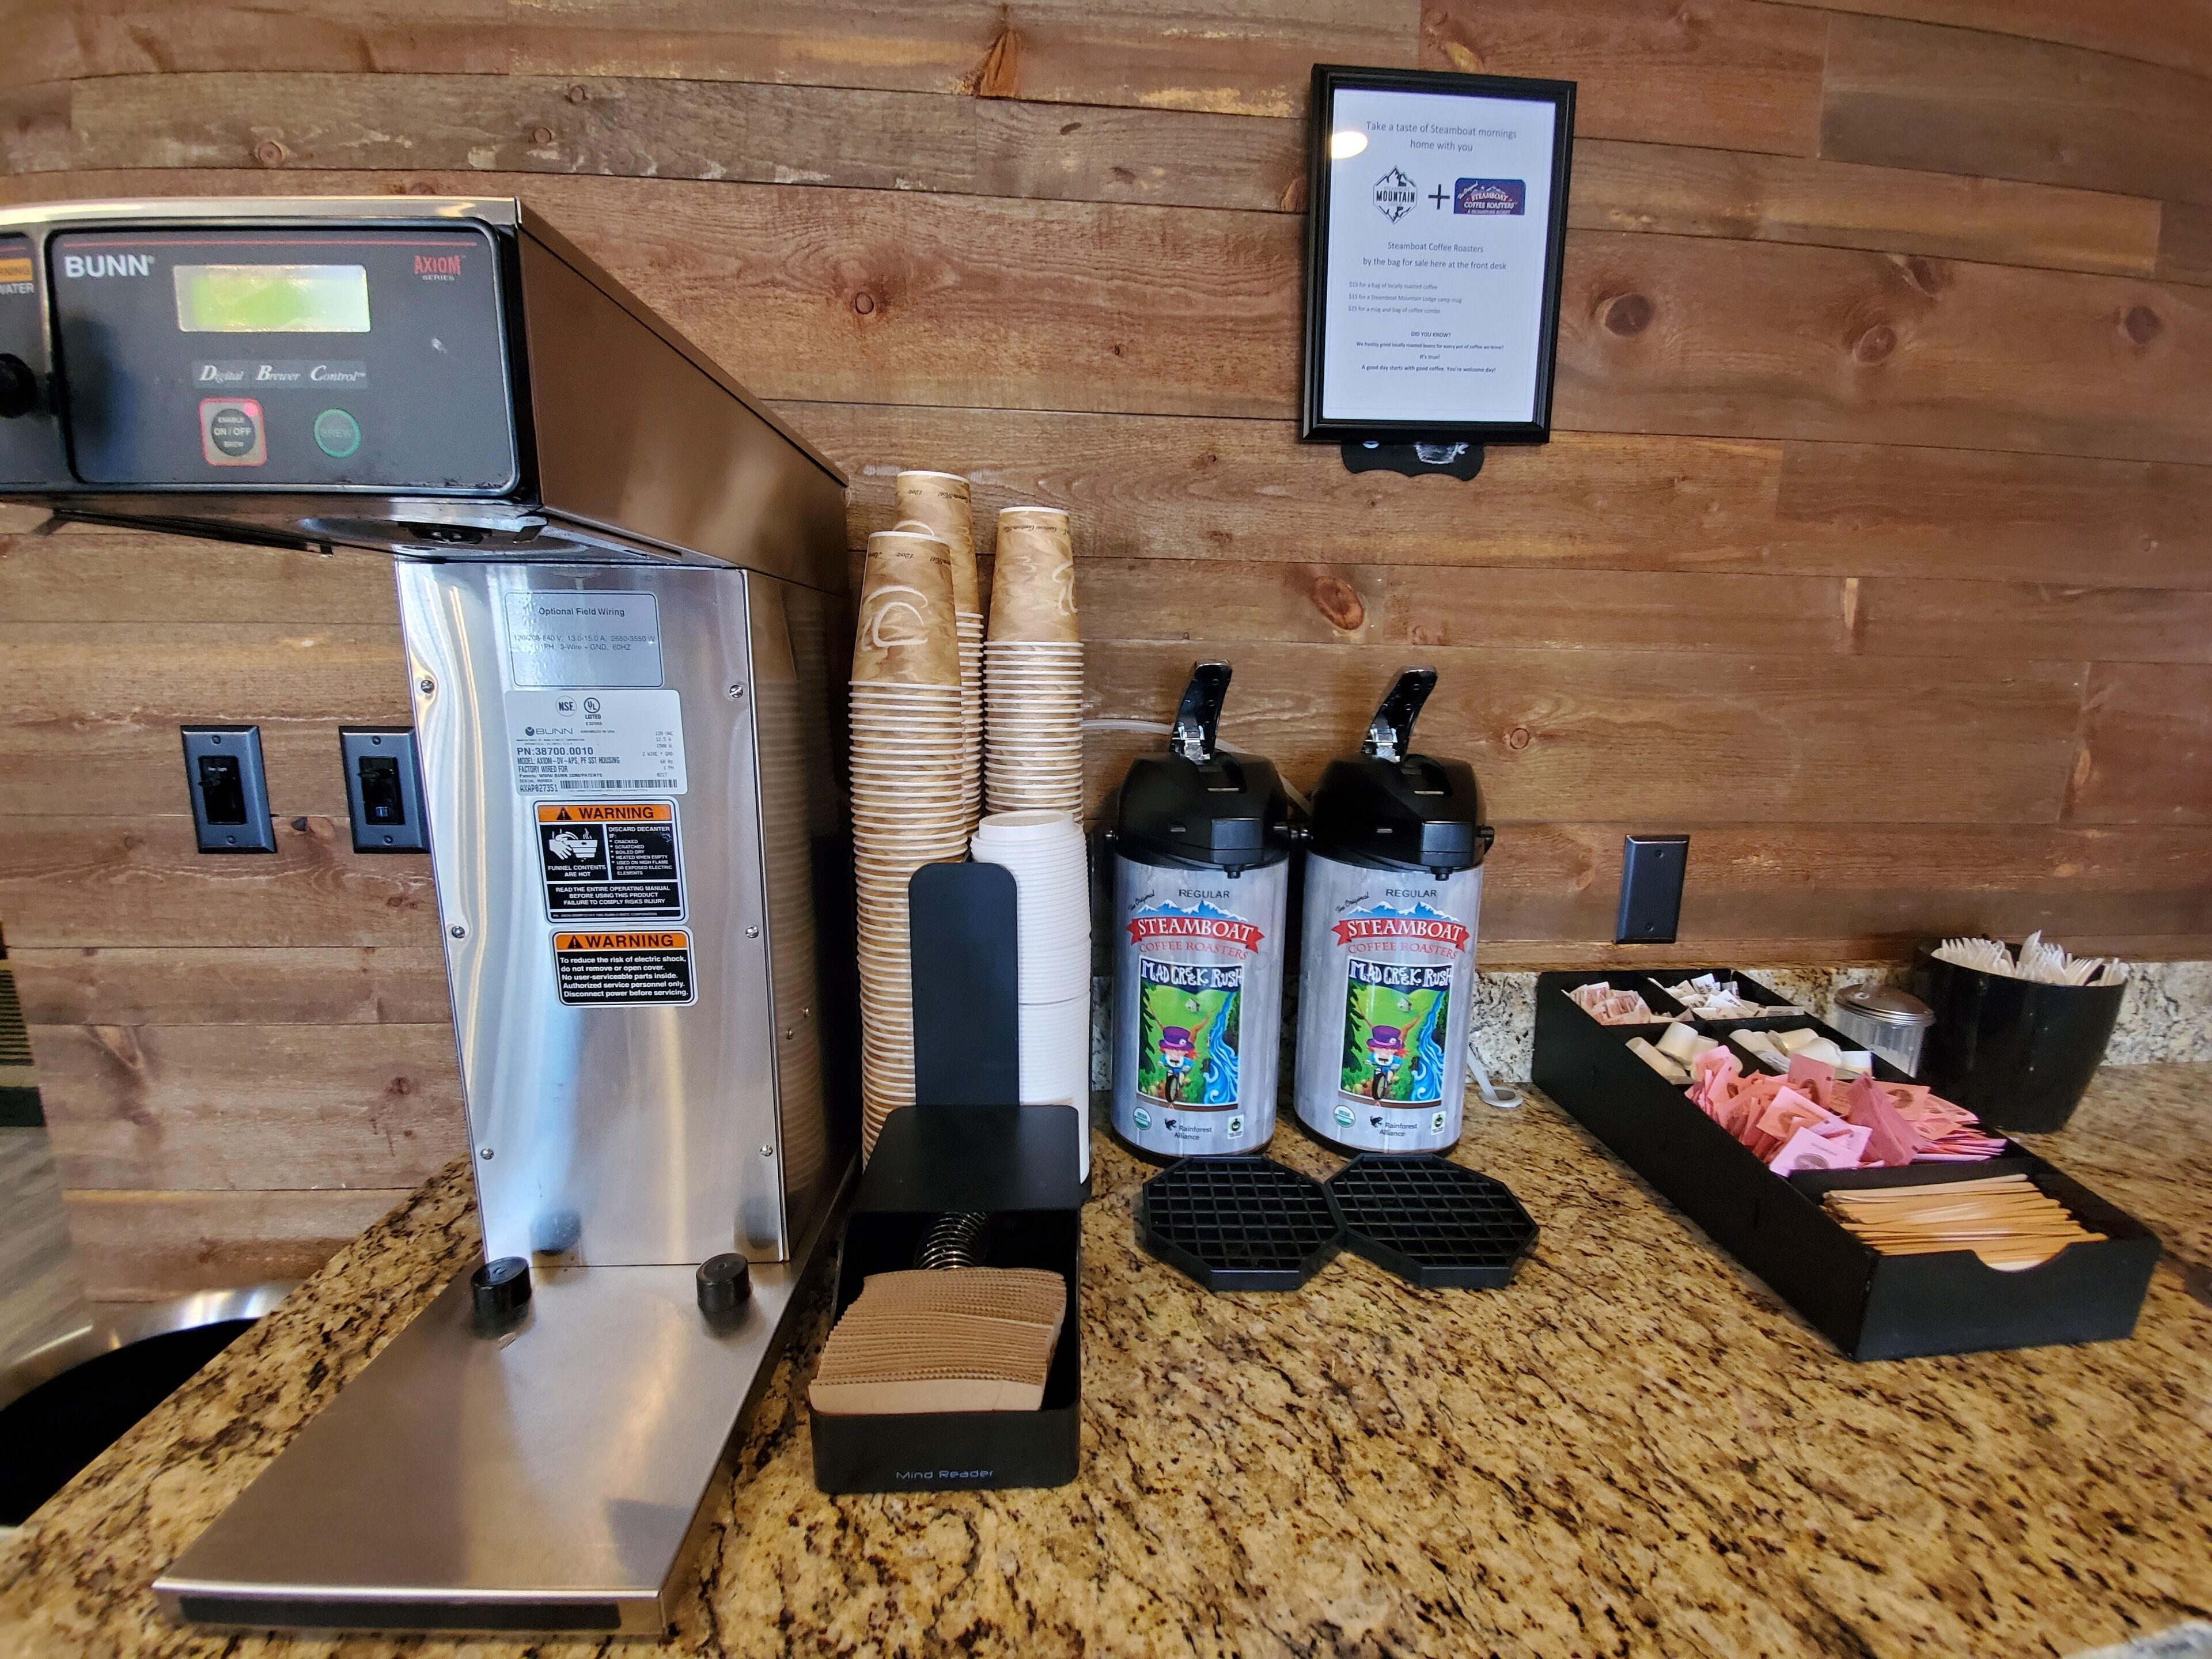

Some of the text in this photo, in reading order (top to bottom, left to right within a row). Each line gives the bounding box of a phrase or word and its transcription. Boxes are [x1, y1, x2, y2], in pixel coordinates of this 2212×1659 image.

[1366, 121, 1386, 131] Take
[1396, 124, 1417, 132] taste
[1420, 124, 1429, 132] of
[1431, 126, 1475, 136] Steamboat
[1479, 130, 1517, 140] mornings
[1410, 139, 1472, 152] home with you
[1376, 191, 1415, 202] MOUNTAIN
[1472, 192, 1509, 202] STEAMBOAT
[1388, 242, 1483, 253] Steamboat Coffee Roasters
[65, 255, 149, 278] BUNN
[414, 255, 461, 275] AXIOM
[1363, 257, 1372, 266] by
[1388, 258, 1400, 267] bag
[1430, 260, 1446, 268] here
[1471, 261, 1488, 269] front
[1490, 262, 1506, 270] desk
[199, 365, 244, 384] Digital
[256, 365, 301, 381] Brewer
[214, 427, 251, 435] ON OFF
[539, 607, 574, 616] Optional
[599, 608, 625, 617] Wiring
[588, 701, 597, 710] UL
[517, 747, 593, 755] PN:38700.0010
[578, 807, 654, 819] WARNING
[1179, 889, 1230, 899] REGULAR
[1386, 889, 1437, 897] REGULAR
[1138, 918, 1255, 942] STEAMBOAT
[1347, 920, 1464, 941] STEAMBOAT
[585, 934, 673, 948] WARNING
[1139, 941, 1249, 960] COFFEE ROASTERS
[1348, 942, 1458, 960] COFFEE ROASTERS
[1141, 960, 1243, 988] MAD CREEK RUSH
[1349, 961, 1452, 987] MAD CREEK RUSH
[631, 981, 666, 989] personnel
[1174, 1132, 1200, 1141] Alliance
[896, 1469, 993, 1479] Mind Reader
